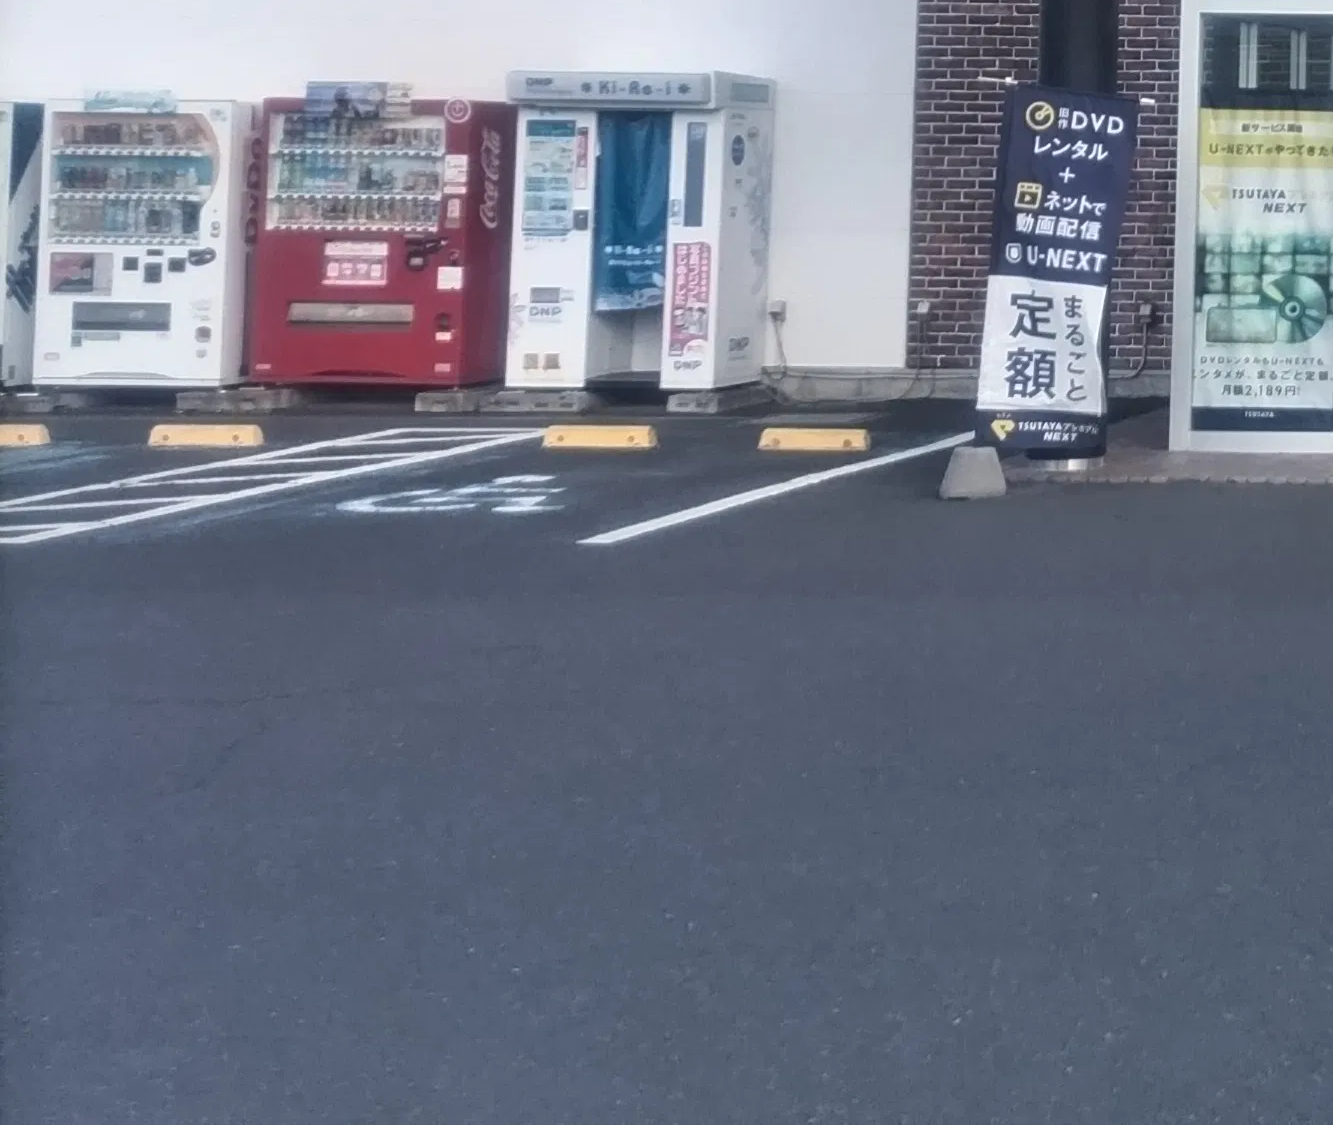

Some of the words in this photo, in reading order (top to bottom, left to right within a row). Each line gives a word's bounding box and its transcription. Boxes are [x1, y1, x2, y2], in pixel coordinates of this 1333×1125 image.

[1071, 111, 1124, 134] DVD
[1033, 136, 1108, 160] レンタル
[1044, 190, 1107, 216] ネットで
[1232, 188, 1287, 200] TSUTAYA
[1262, 202, 1308, 214] NEXT
[1015, 212, 1102, 241] 動画配信
[1026, 245, 1107, 274] U-NEXT
[1003, 289, 1057, 400] 定額
[1063, 294, 1088, 402] まるごと
[1042, 431, 1078, 443] NEXT
